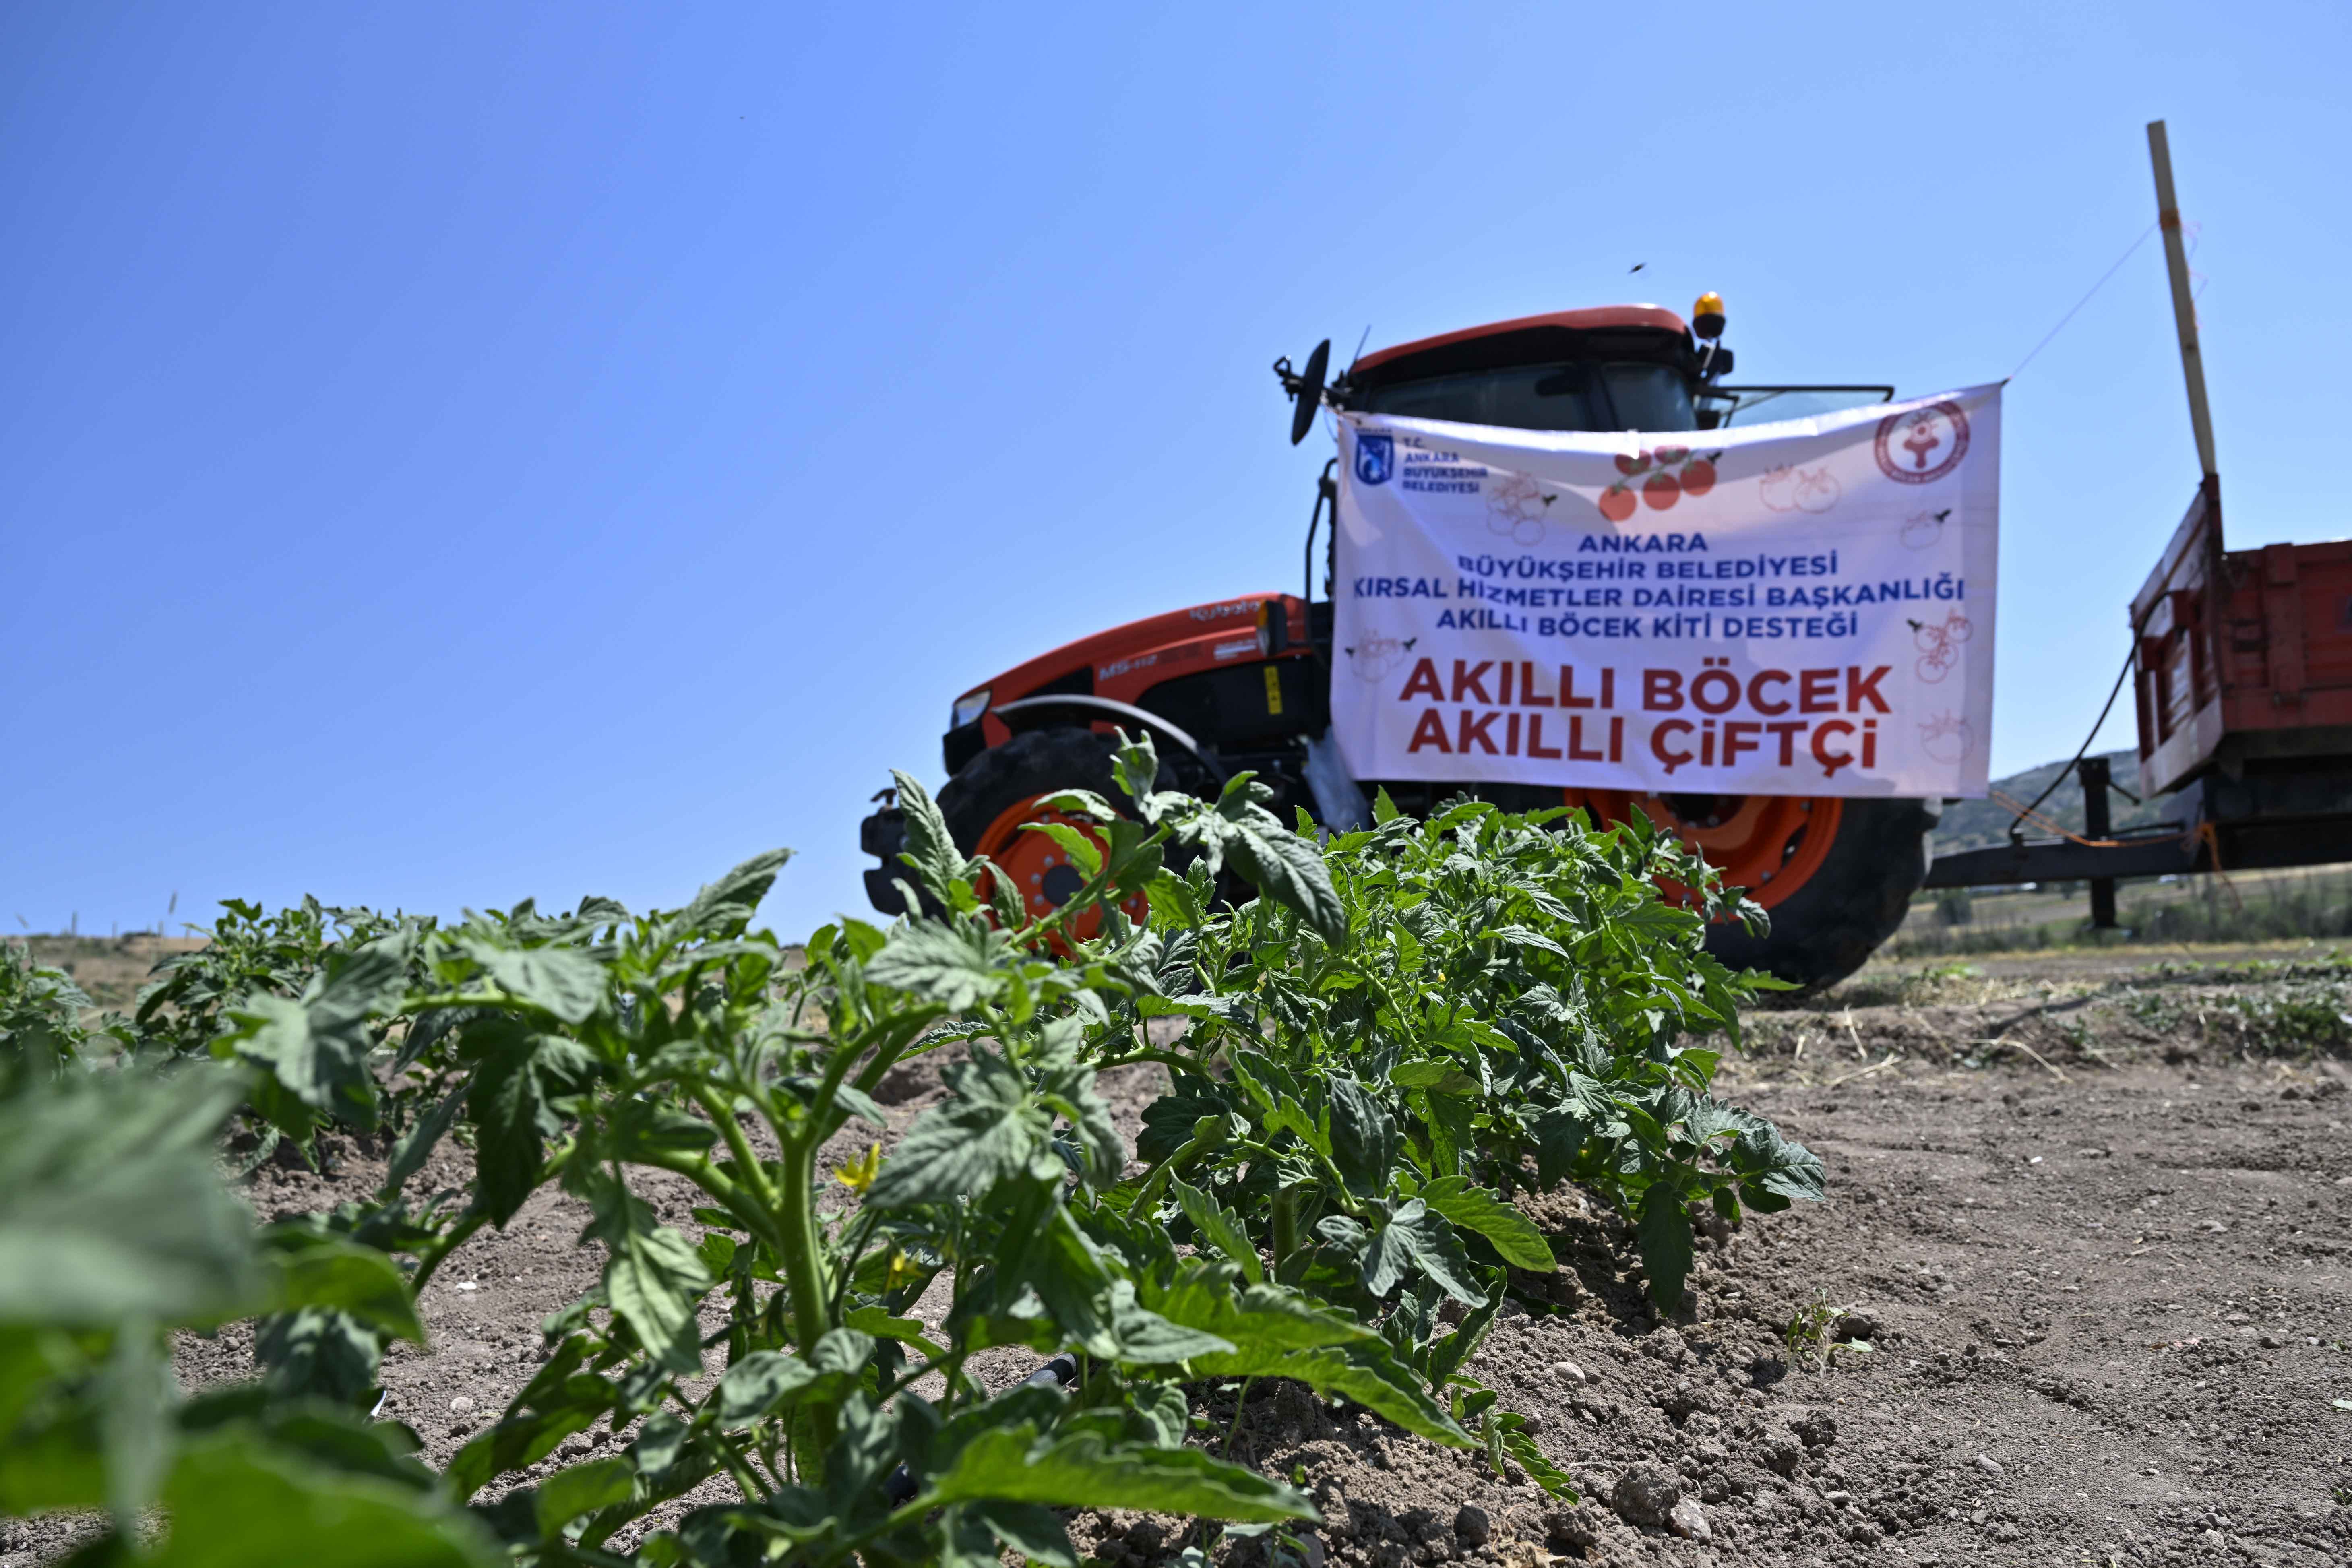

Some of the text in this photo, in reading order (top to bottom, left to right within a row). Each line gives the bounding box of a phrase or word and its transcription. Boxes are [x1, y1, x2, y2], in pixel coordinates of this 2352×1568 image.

[1404, 452, 1459, 463] ANKARA
[1577, 533, 1708, 554] ANKARA
[1458, 550, 1837, 583] BÜYÜKŞEHİR BELEDİYESİ
[1353, 577, 1448, 599] KIRSAL
[1633, 583, 1755, 607] DAİRESİ
[1766, 572, 1965, 610] BAŞKANLIĞI
[1436, 609, 1857, 638] AKILLI BÖCEK KİTİ DESTEĞİ
[1399, 657, 1892, 715] AKILLI BÖCEK
[1407, 709, 1877, 778] AKILLI ÇİFTÇİ
